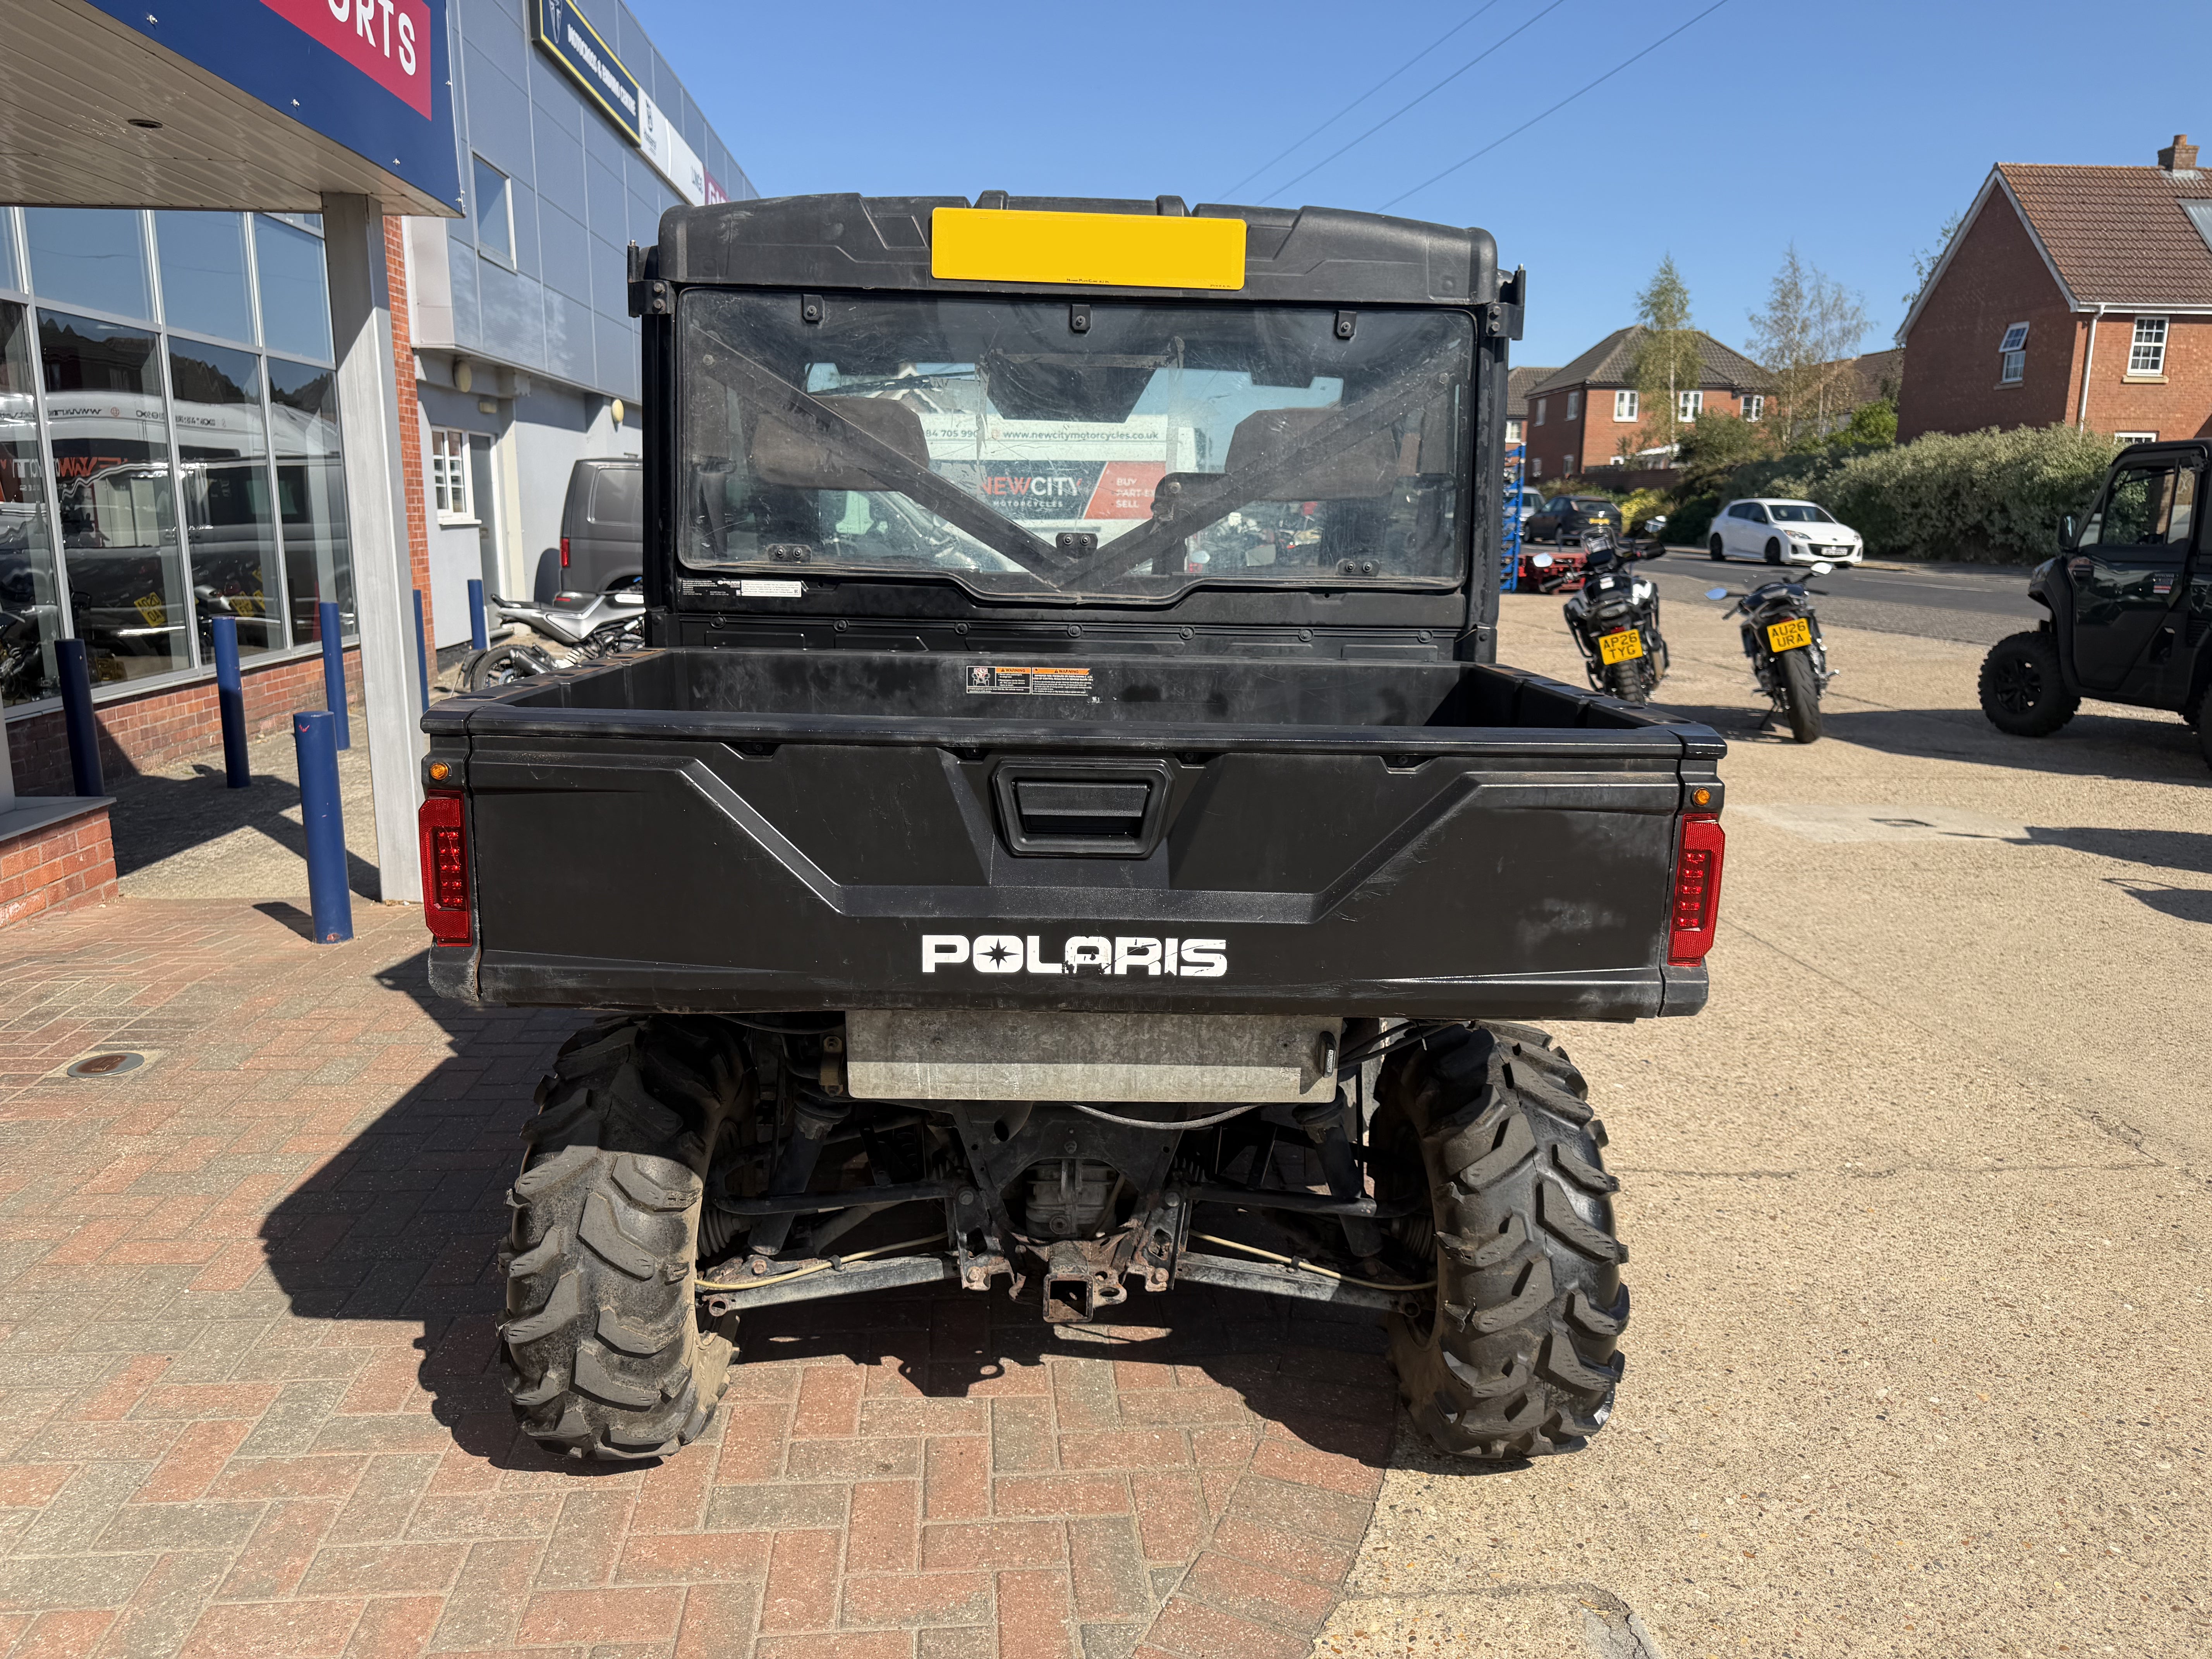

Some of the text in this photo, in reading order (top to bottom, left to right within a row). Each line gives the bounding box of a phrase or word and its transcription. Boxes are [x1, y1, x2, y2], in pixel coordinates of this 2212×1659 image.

[1003, 431, 1159, 441] www.newcitymotorcycles.co.uk
[1116, 477, 1137, 486] BUY
[1116, 500, 1139, 508] SELL
[1772, 621, 1806, 638] AU26
[1604, 632, 1637, 650] AP26
[1777, 634, 1803, 647] URA
[922, 934, 1228, 977] POLARIS
